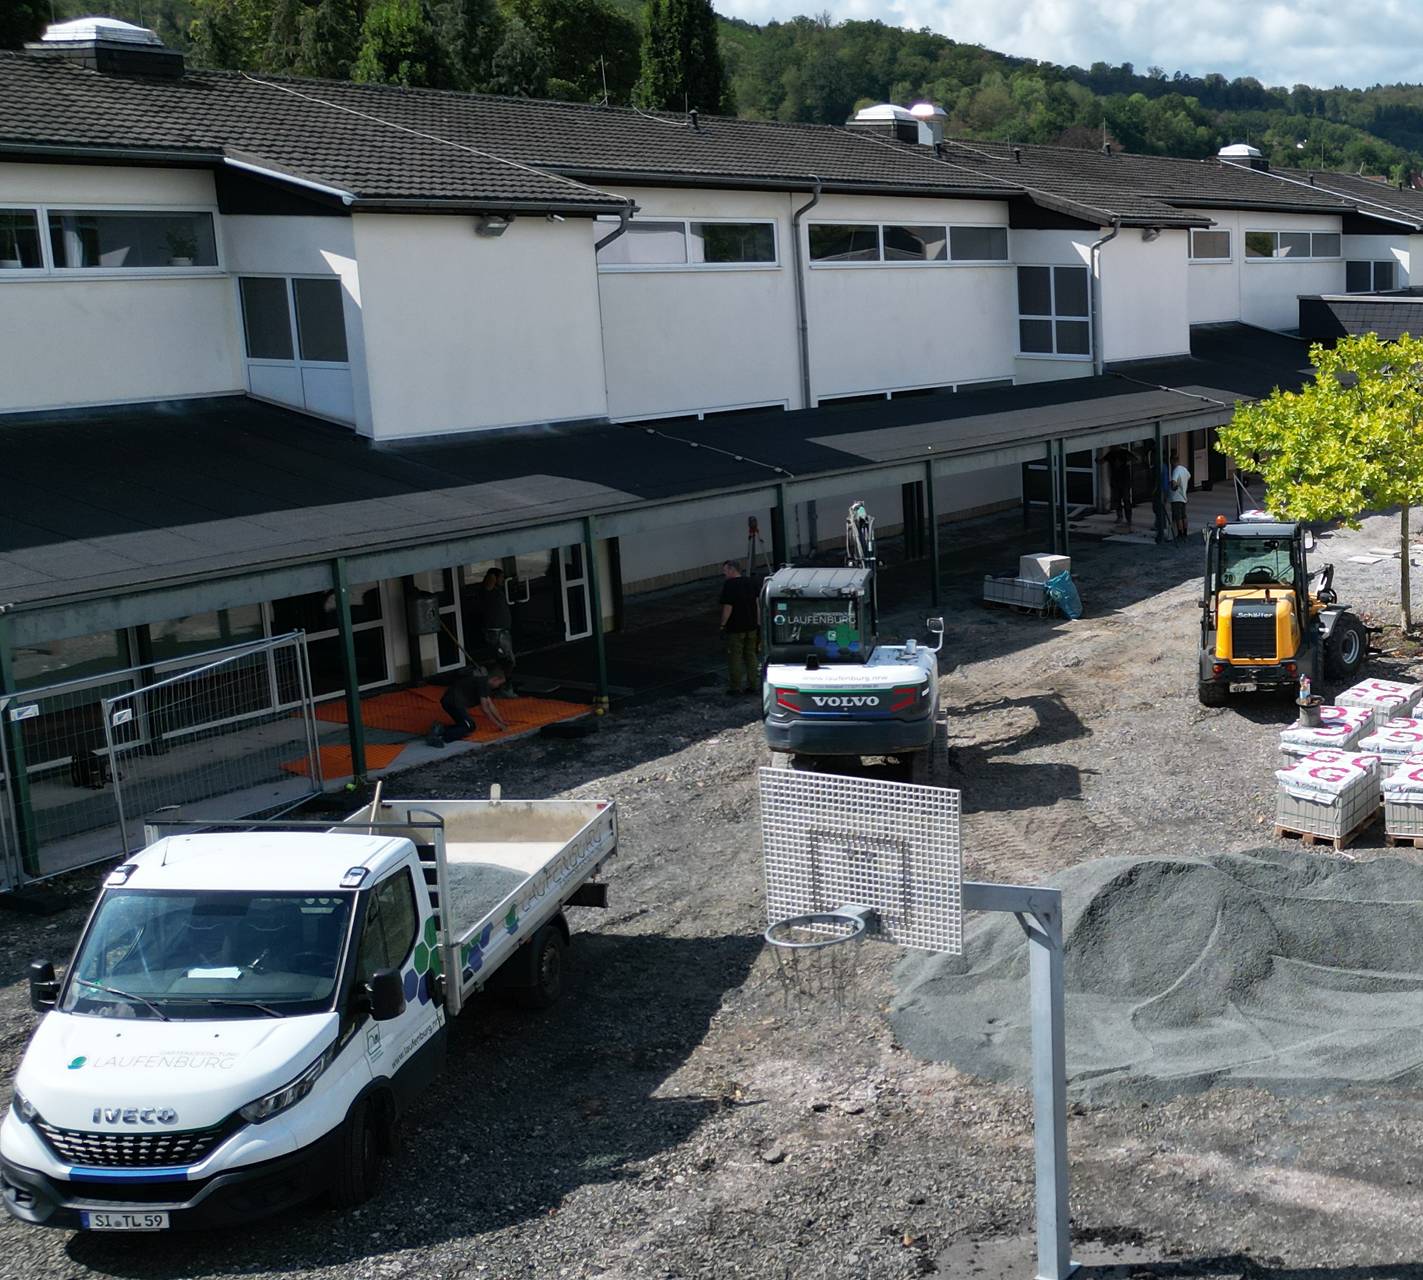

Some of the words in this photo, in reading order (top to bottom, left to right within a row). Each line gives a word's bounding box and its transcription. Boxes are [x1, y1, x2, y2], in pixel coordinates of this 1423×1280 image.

[788, 615, 856, 624] LAUFENBURG
[812, 696, 880, 706] VOLVO
[523, 821, 602, 912] LAUFENBURG
[92, 1055, 236, 1070] LAUFENBURG
[92, 1107, 178, 1125] IVECO
[95, 1215, 112, 1227] SI
[122, 1215, 141, 1227] TL
[144, 1215, 163, 1227] 59
